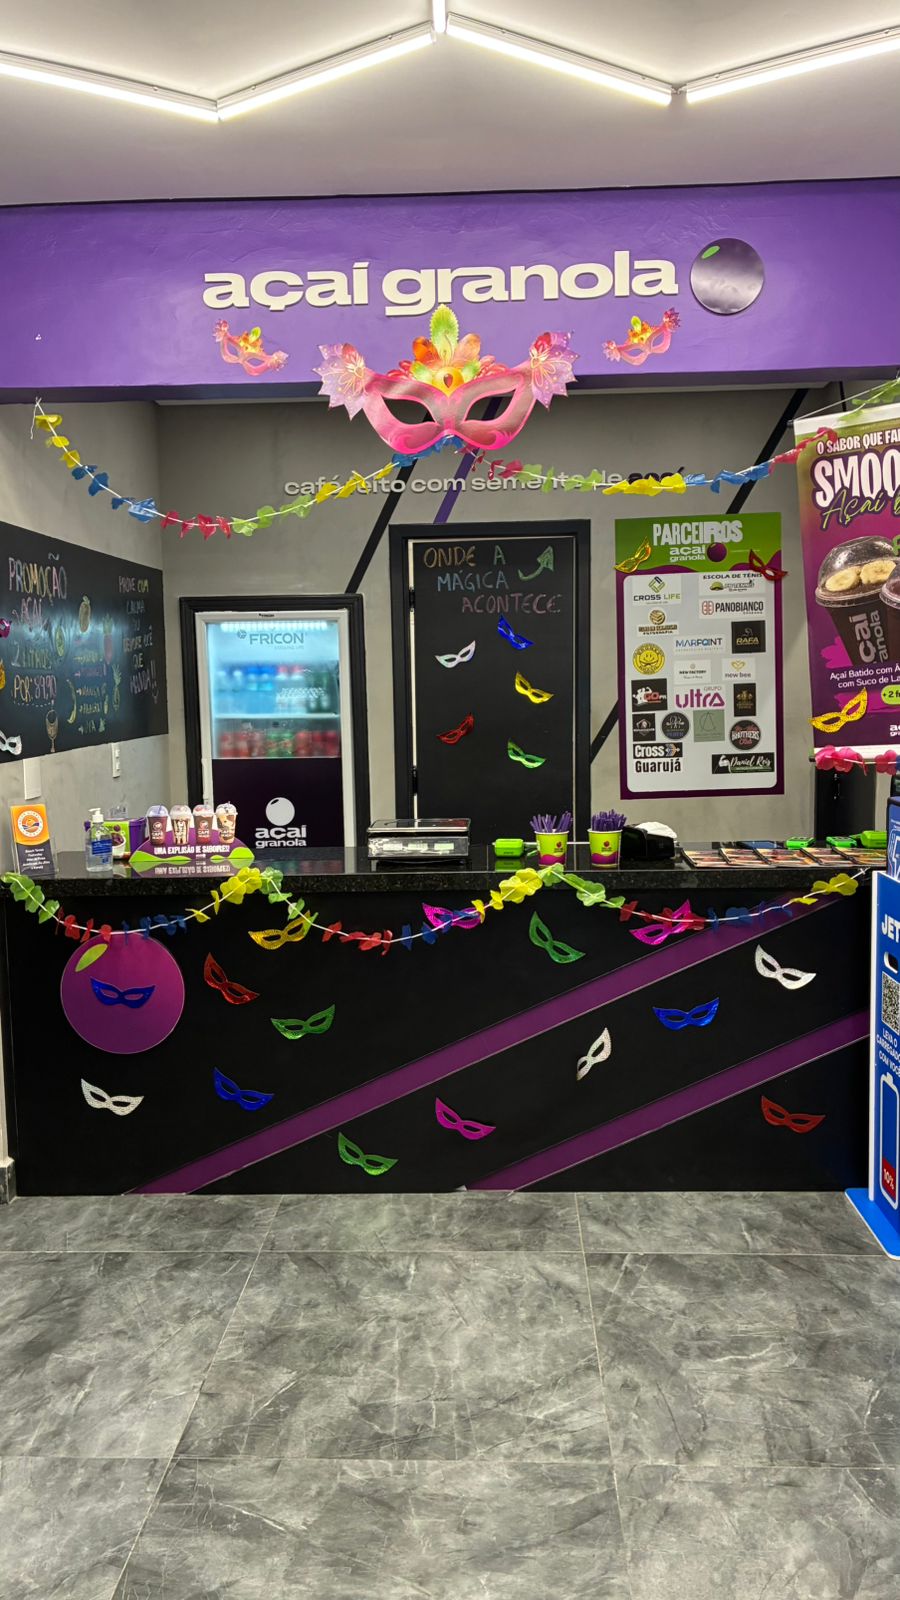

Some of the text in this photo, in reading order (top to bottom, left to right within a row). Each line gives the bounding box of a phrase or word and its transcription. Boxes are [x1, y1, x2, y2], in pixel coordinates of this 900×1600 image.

[203, 251, 678, 316] açaí granola
[817, 428, 900, 454] O SABOR QUE FA
[411, 477, 466, 493] com
[653, 520, 743, 546] PARCEIROS
[424, 545, 506, 568] ONDE A
[669, 553, 706, 563] granola
[437, 570, 509, 592] MÁGICA
[462, 594, 562, 614] ACONTECE
[715, 601, 764, 612] PANOBIANCO
[249, 632, 304, 645] FRICON
[830, 671, 847, 681] Açaí
[849, 667, 874, 677] Batido
[856, 677, 876, 686] Suco
[878, 675, 889, 683] de
[635, 745, 665, 757] Cross
[635, 758, 681, 773] Guarujá
[255, 838, 307, 849] granola
